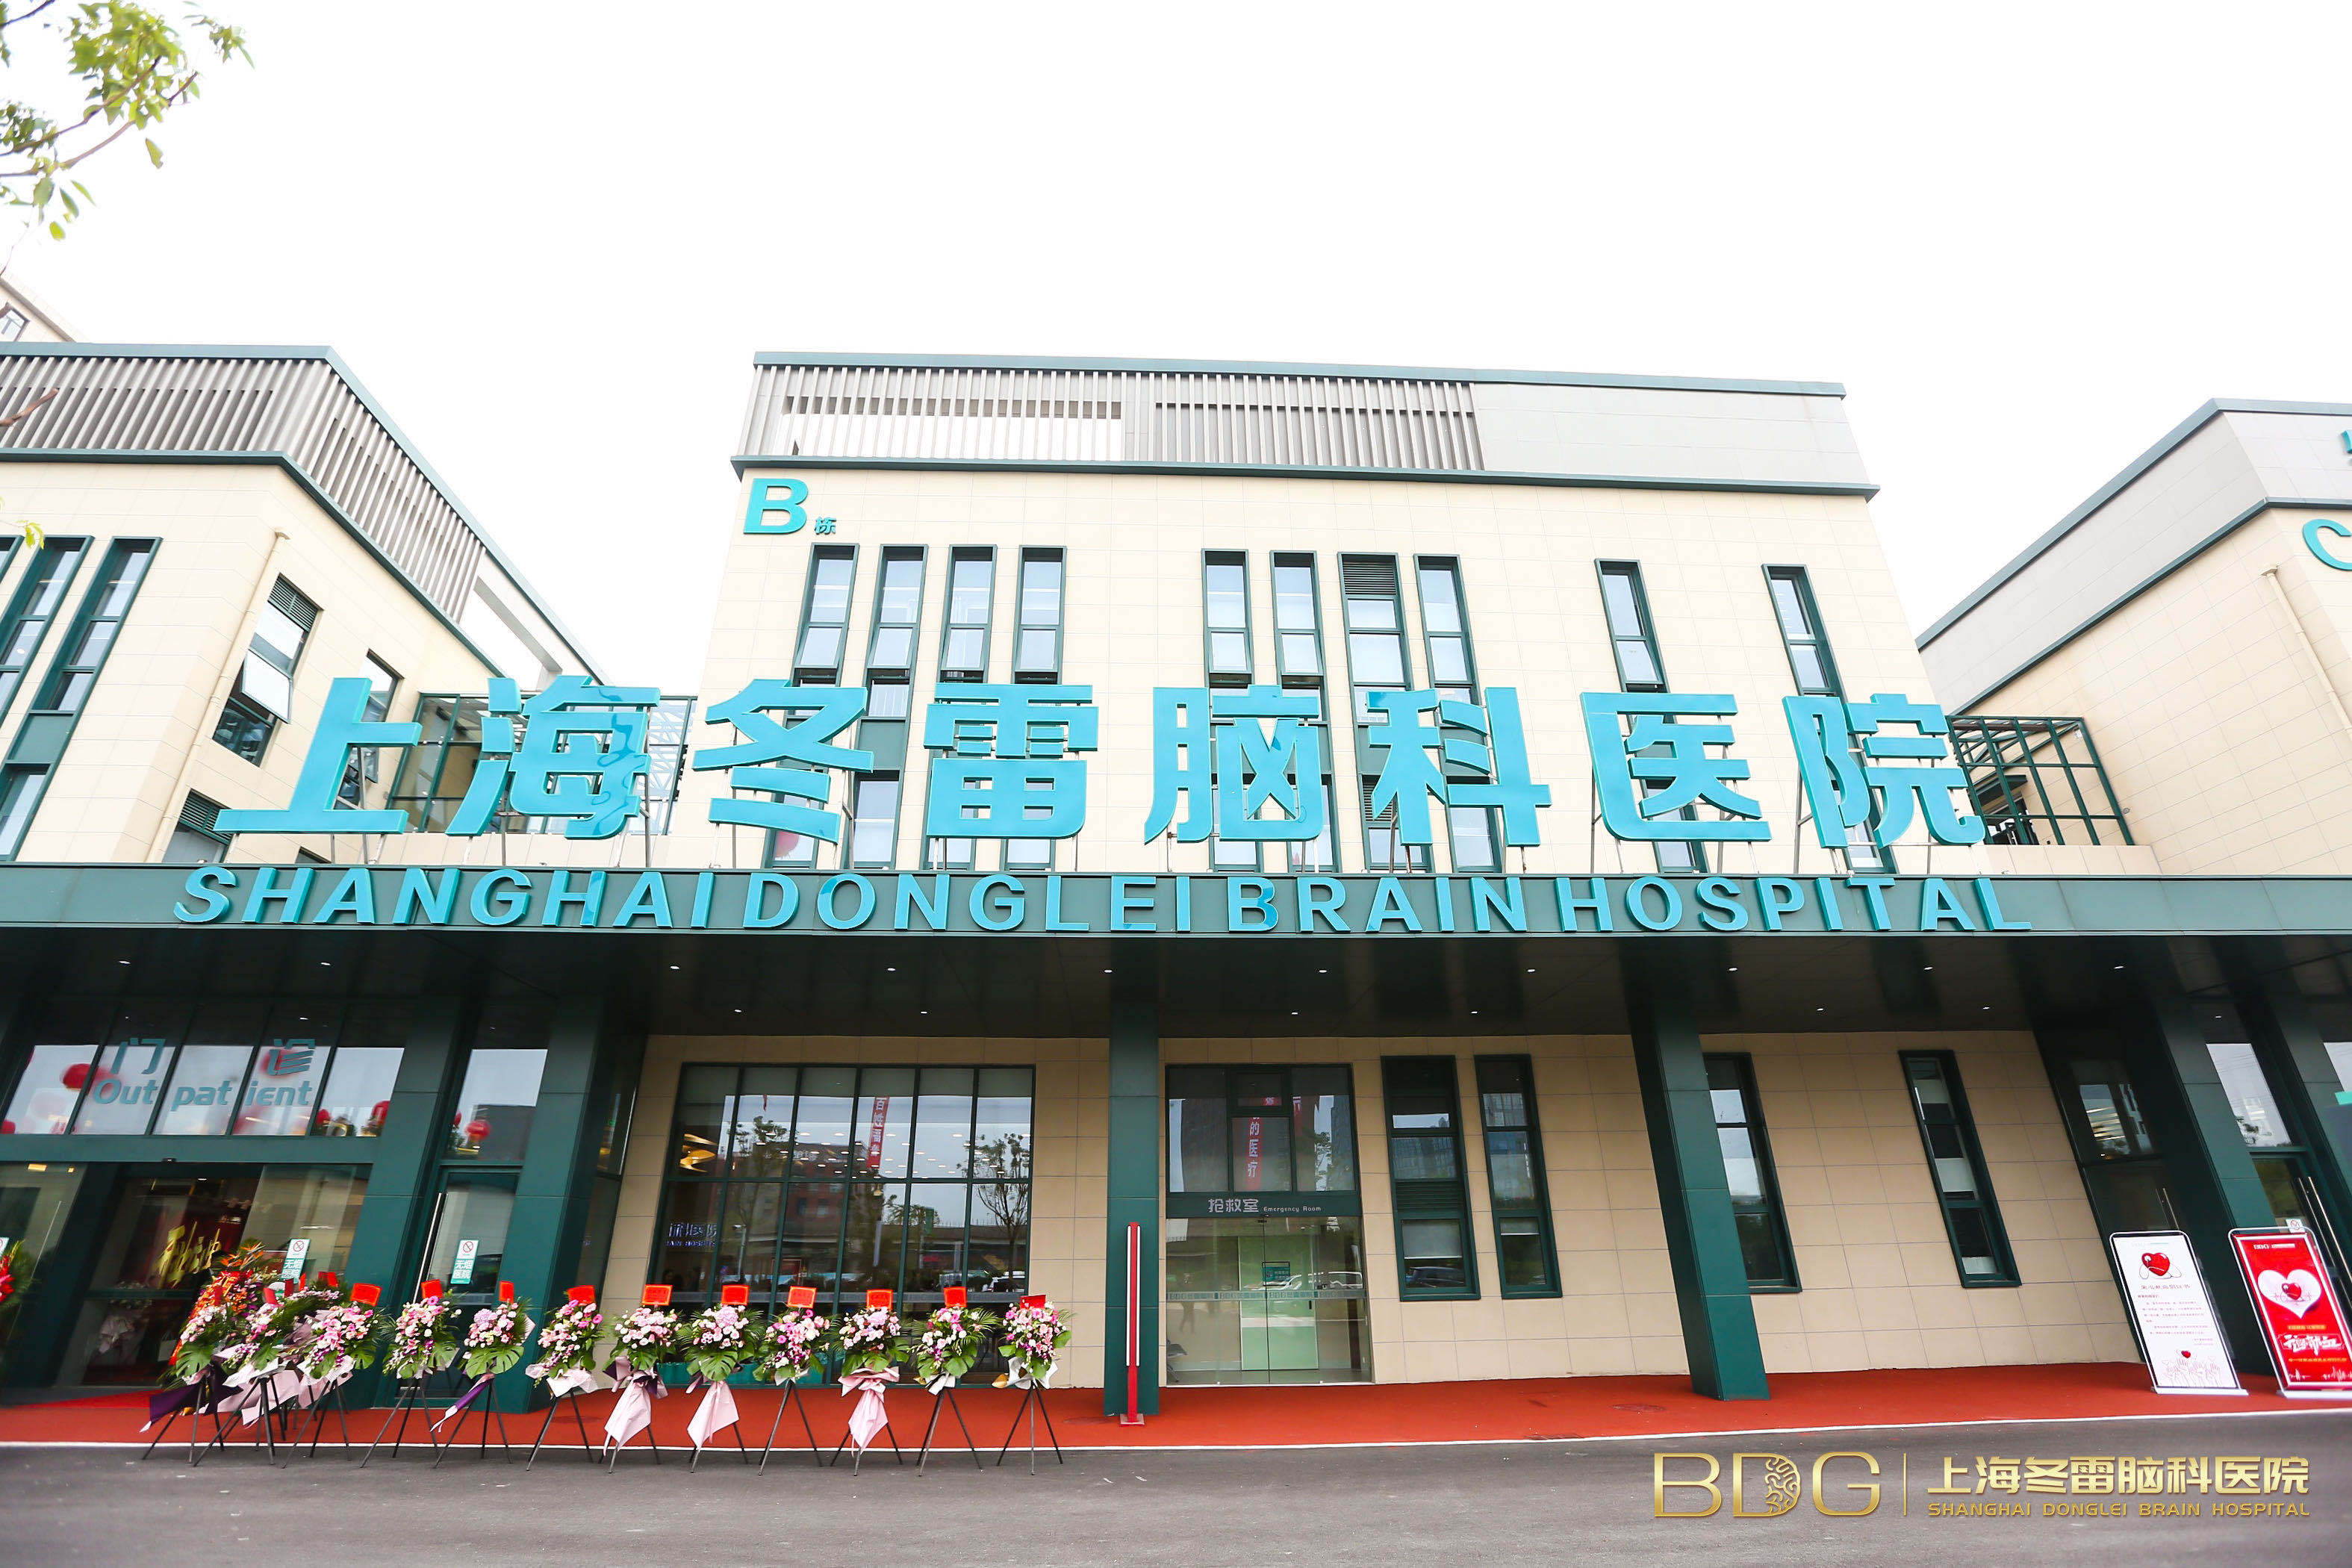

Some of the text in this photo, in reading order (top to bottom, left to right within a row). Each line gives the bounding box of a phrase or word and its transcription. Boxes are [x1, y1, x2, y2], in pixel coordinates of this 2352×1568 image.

[214, 674, 1986, 849] 上海冬雷脑科医院
[172, 866, 2032, 933] SHANGHAI DONGLEI BRAIN HOSPITAL
[1208, 1198, 1259, 1213] 抢救室
